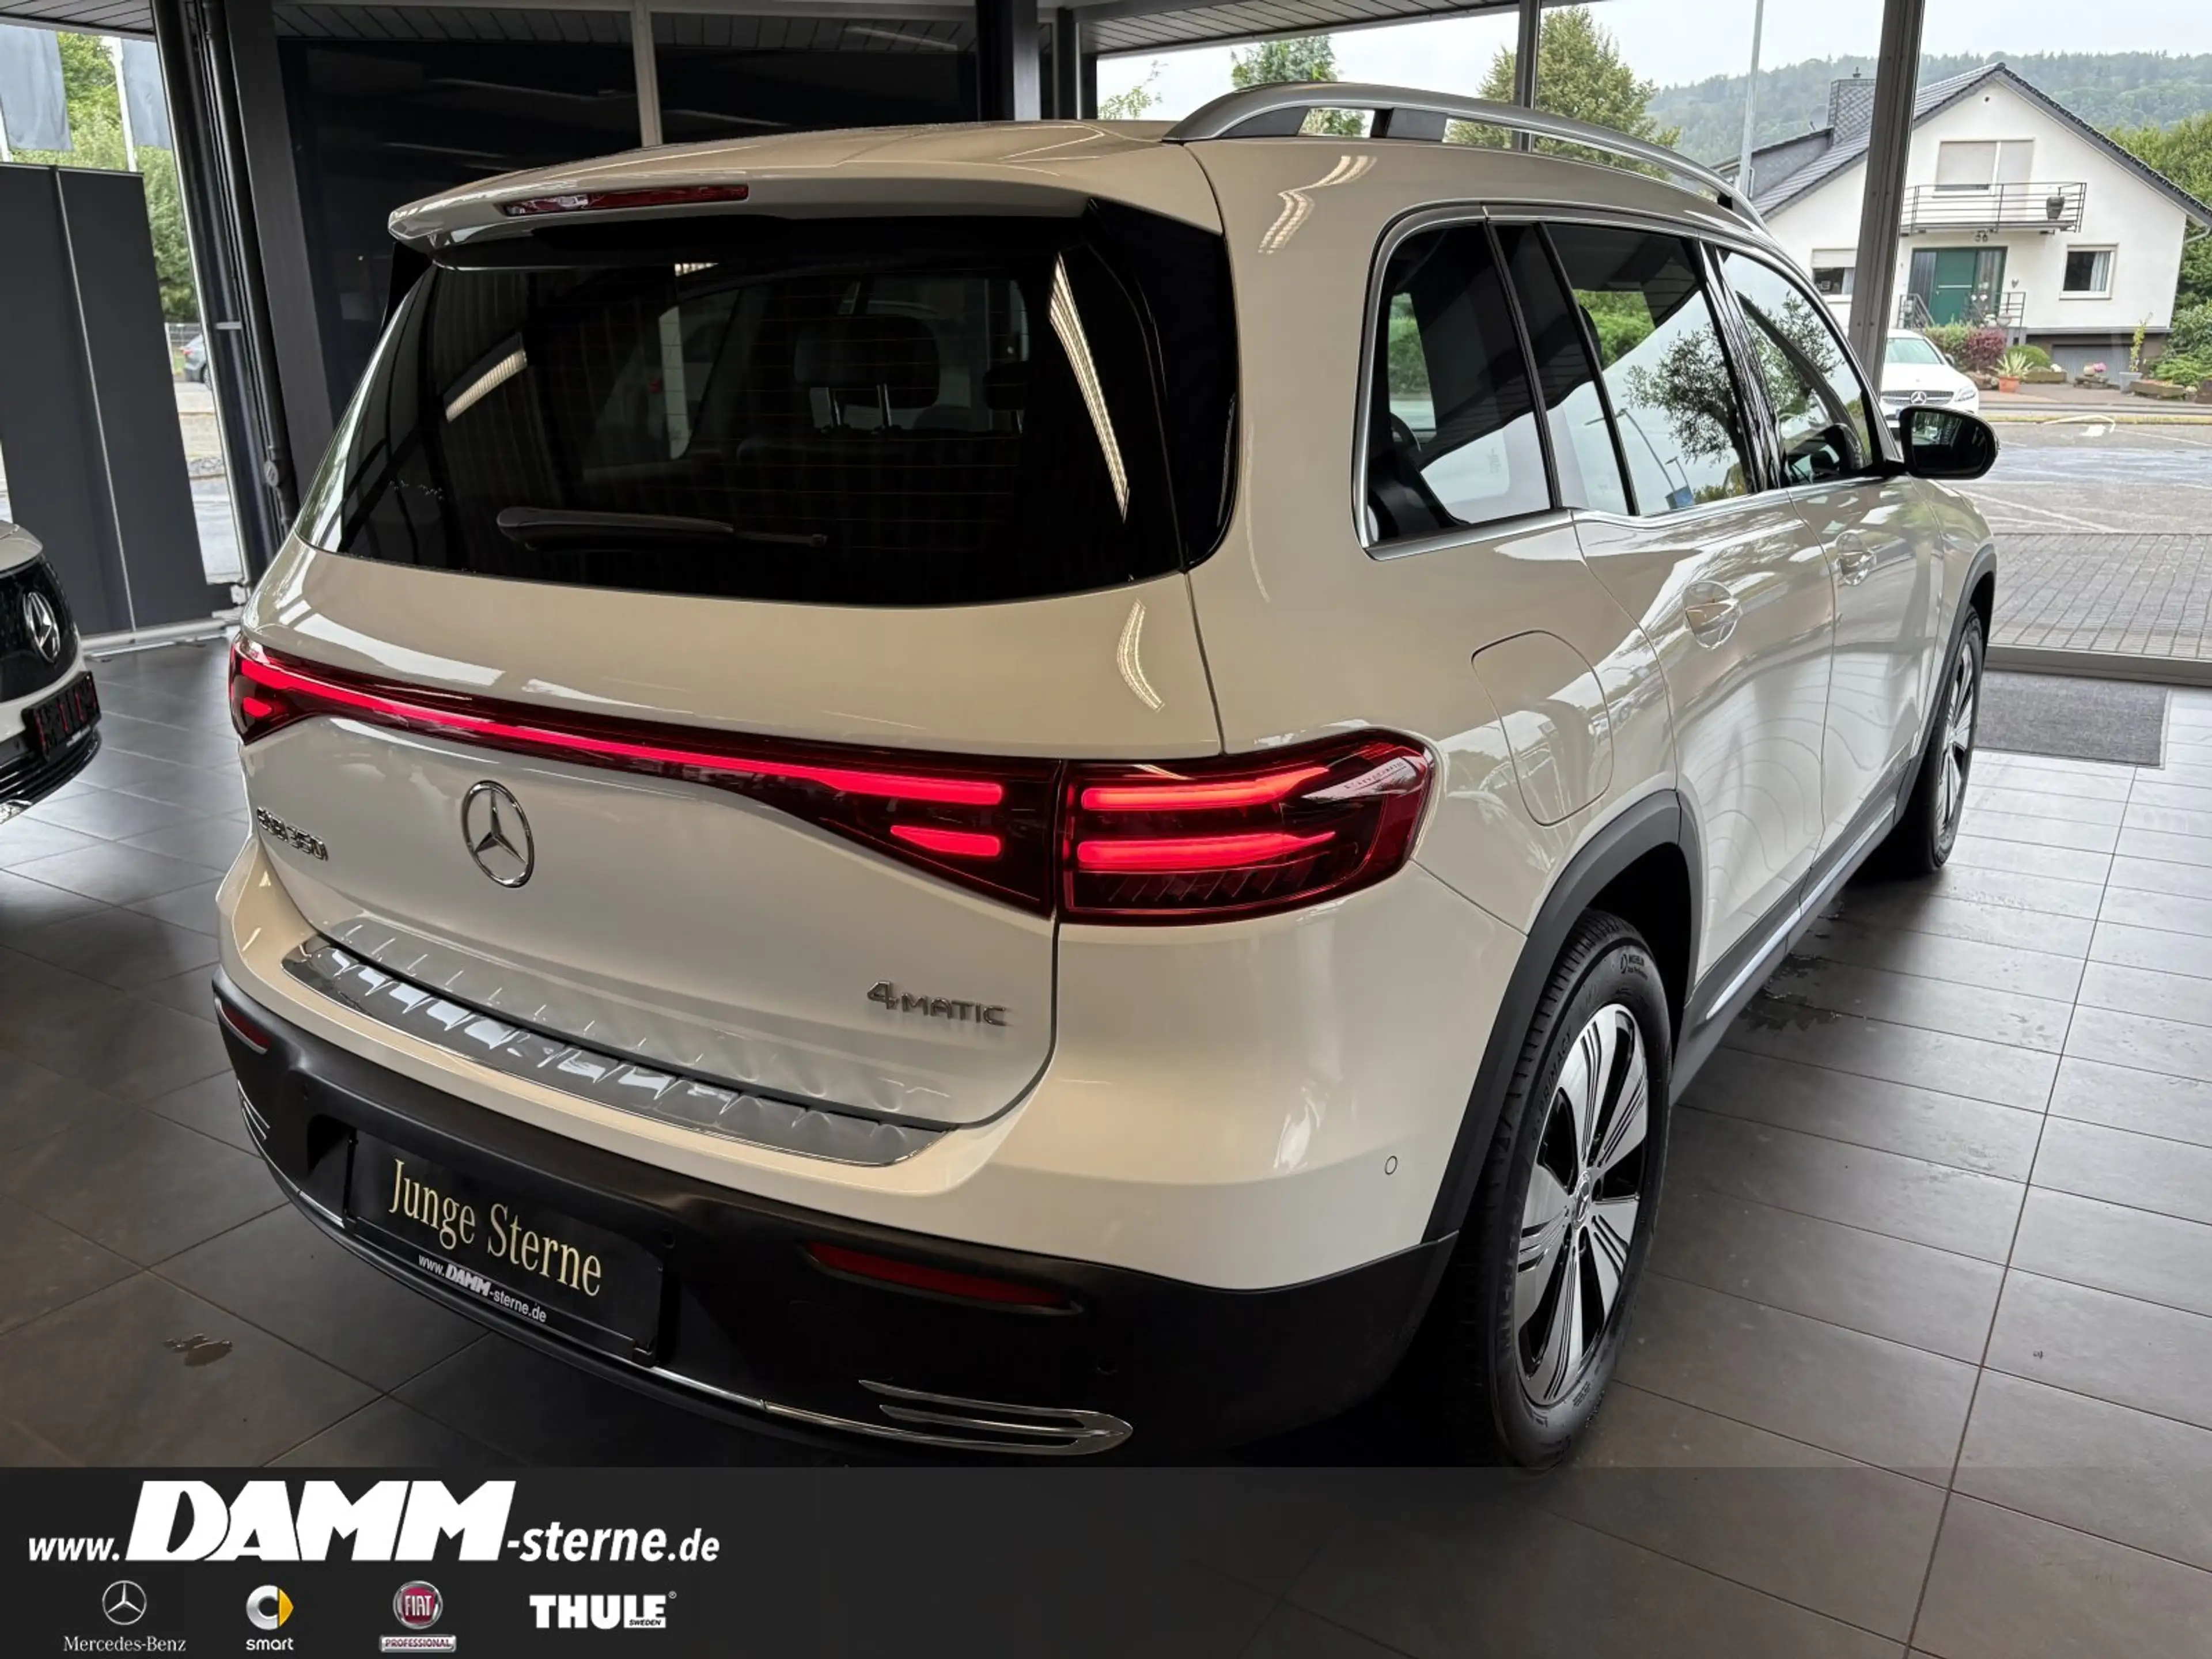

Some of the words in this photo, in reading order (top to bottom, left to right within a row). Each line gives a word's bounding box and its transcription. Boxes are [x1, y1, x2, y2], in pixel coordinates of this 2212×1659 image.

[866, 980, 1009, 1027] 4MATIC
[388, 1158, 476, 1250] Junge
[487, 1202, 602, 1297] Sterne
[418, 1253, 547, 1323] www.DAMM-sterne.de
